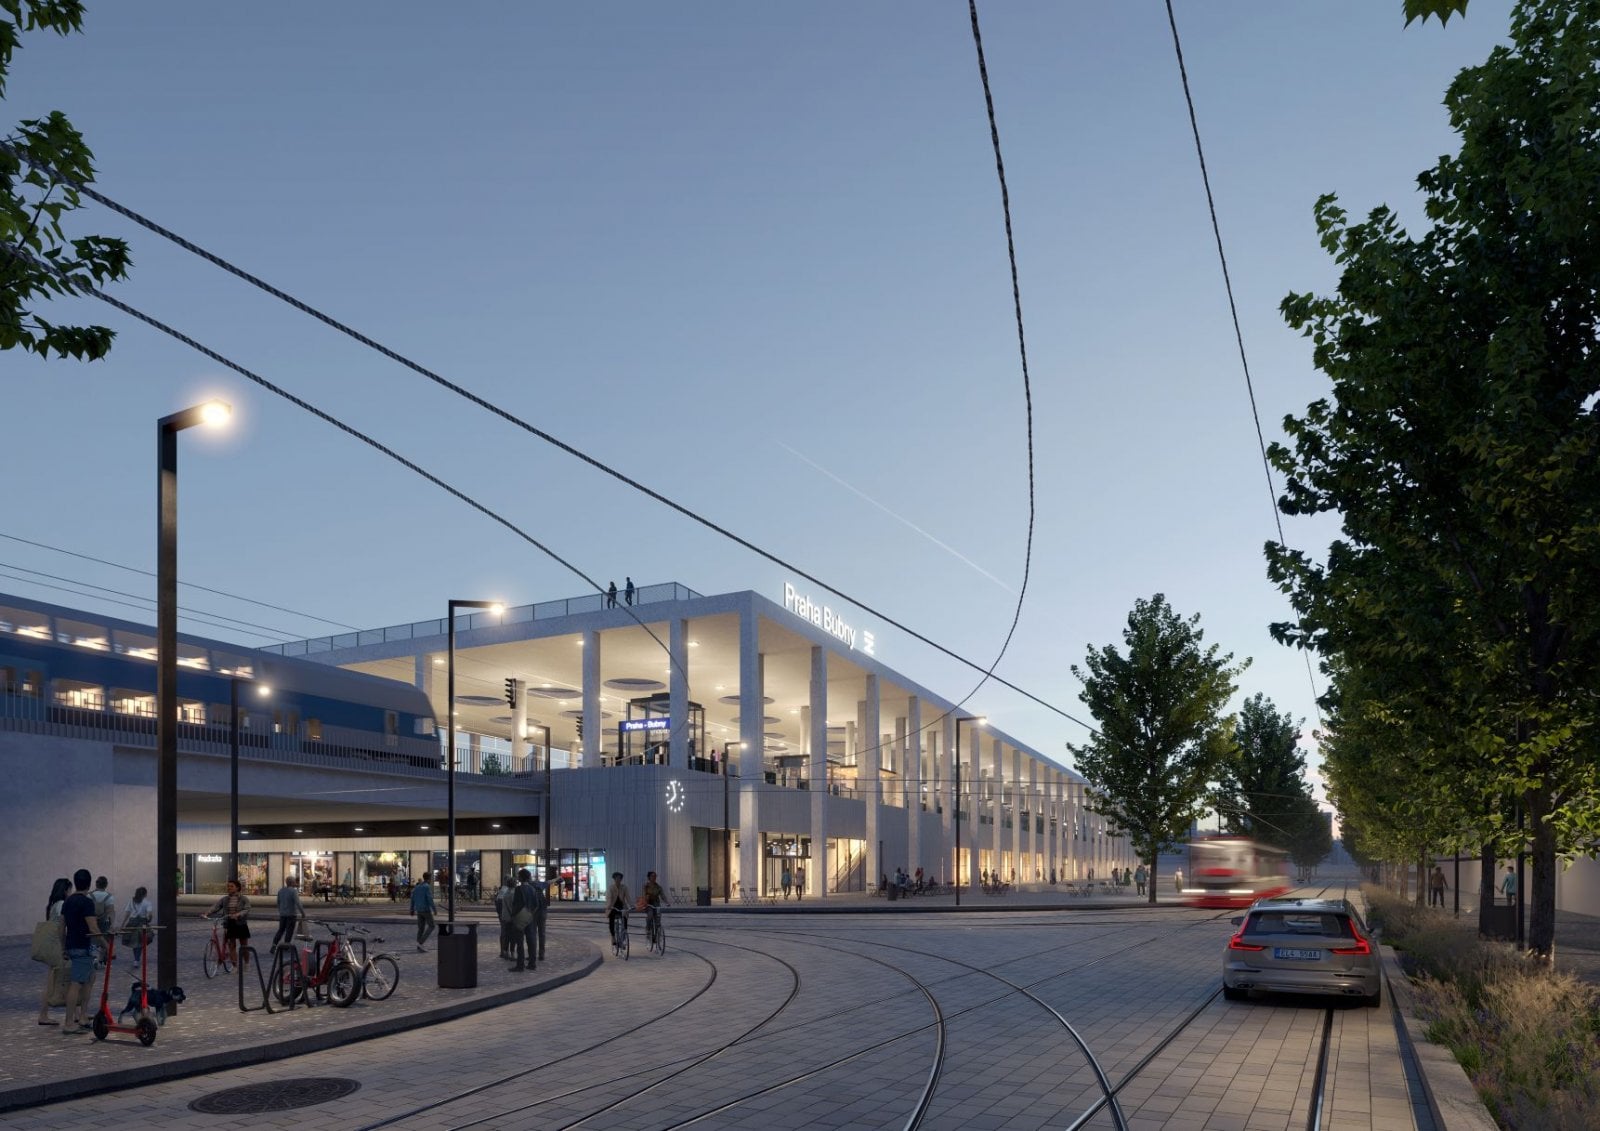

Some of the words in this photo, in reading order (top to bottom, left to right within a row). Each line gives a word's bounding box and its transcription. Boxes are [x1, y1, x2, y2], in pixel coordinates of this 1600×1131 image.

[784, 582, 820, 626] Praha
[823, 606, 856, 650] Bubny
[625, 721, 643, 730] Praha
[647, 720, 666, 729] Bubny
